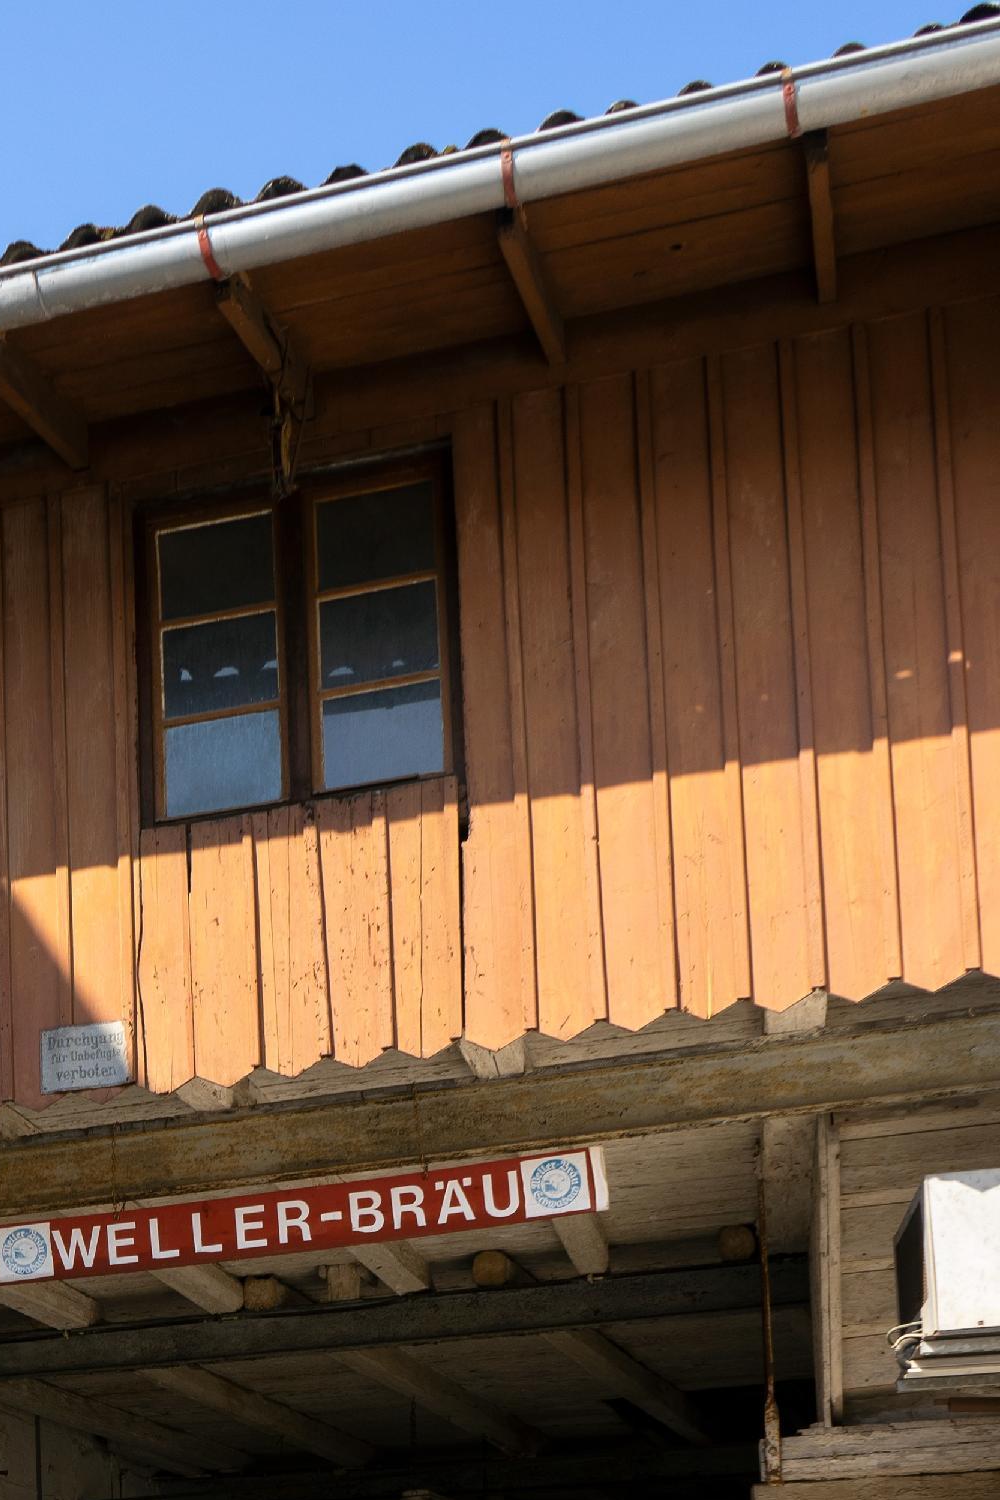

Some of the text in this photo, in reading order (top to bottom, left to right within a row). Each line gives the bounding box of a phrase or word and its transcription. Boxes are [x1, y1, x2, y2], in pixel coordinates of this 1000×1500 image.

[47, 1031, 123, 1051] Durchgang
[56, 1063, 117, 1081] verboten
[51, 1171, 520, 1270] WELLER-BRÄU
